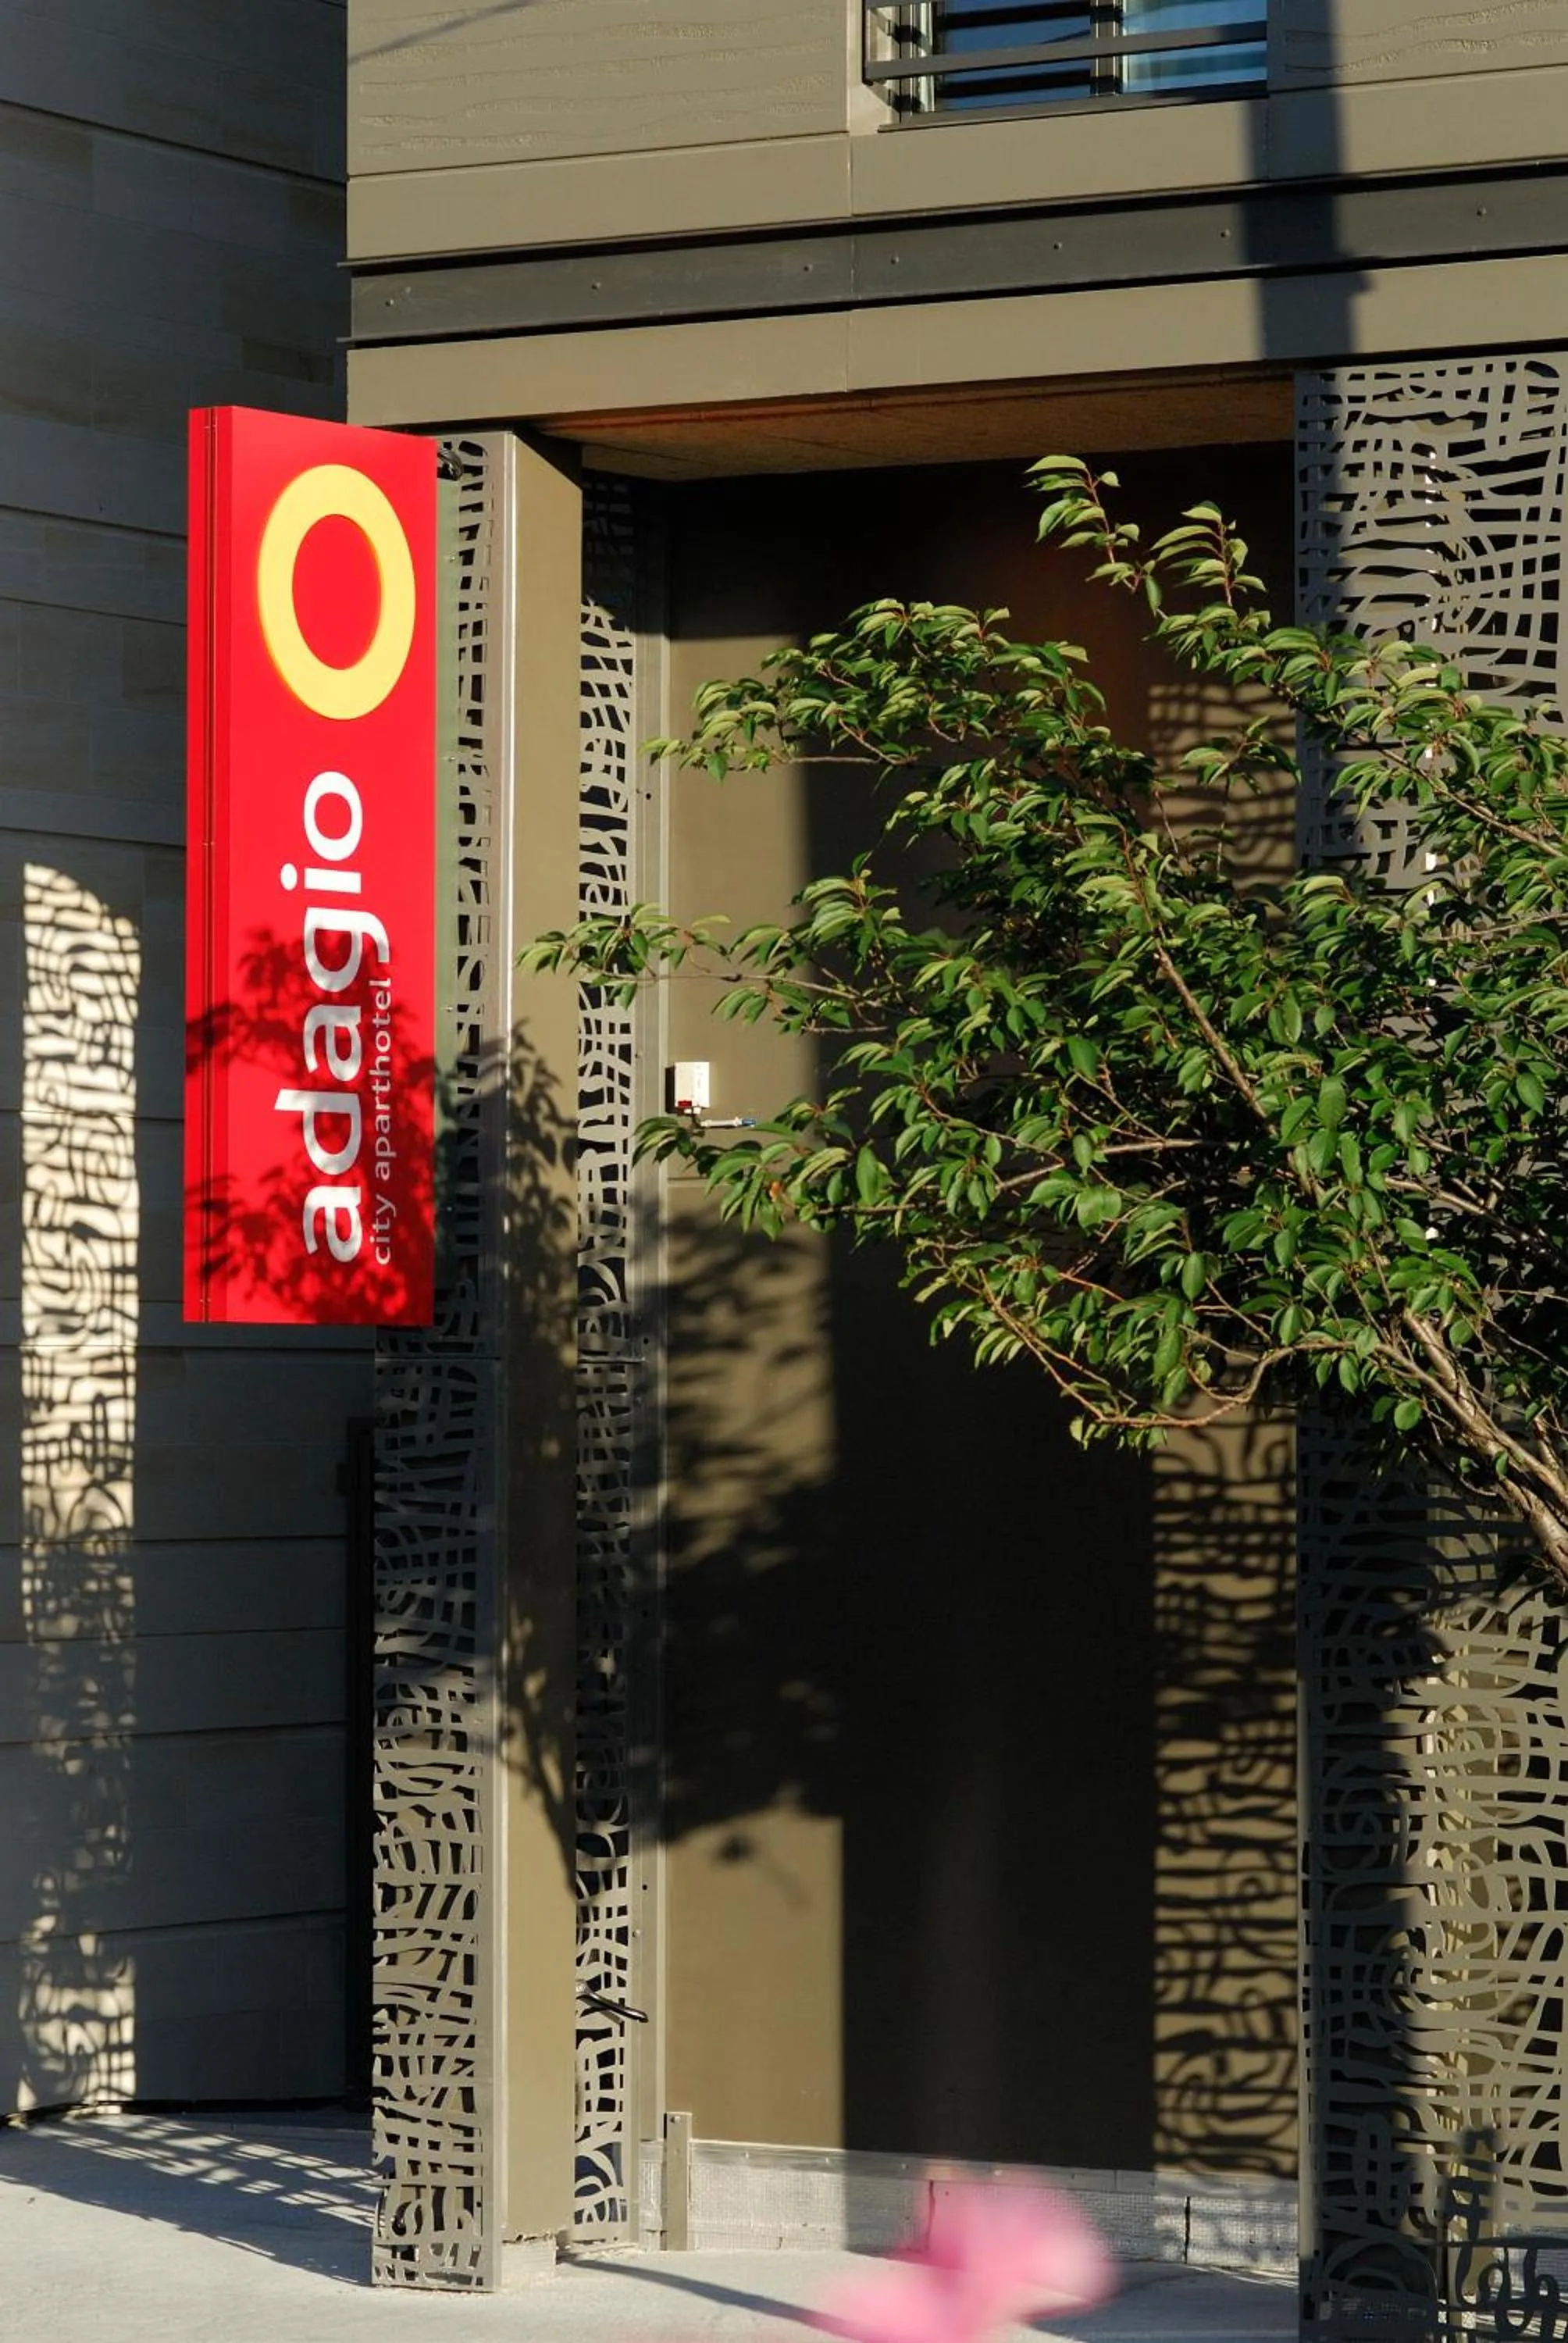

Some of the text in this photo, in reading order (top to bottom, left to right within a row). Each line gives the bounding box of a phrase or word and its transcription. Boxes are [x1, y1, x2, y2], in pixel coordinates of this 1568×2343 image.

[273, 770, 391, 1263] adagio
[369, 977, 397, 1265] city aparthotel
